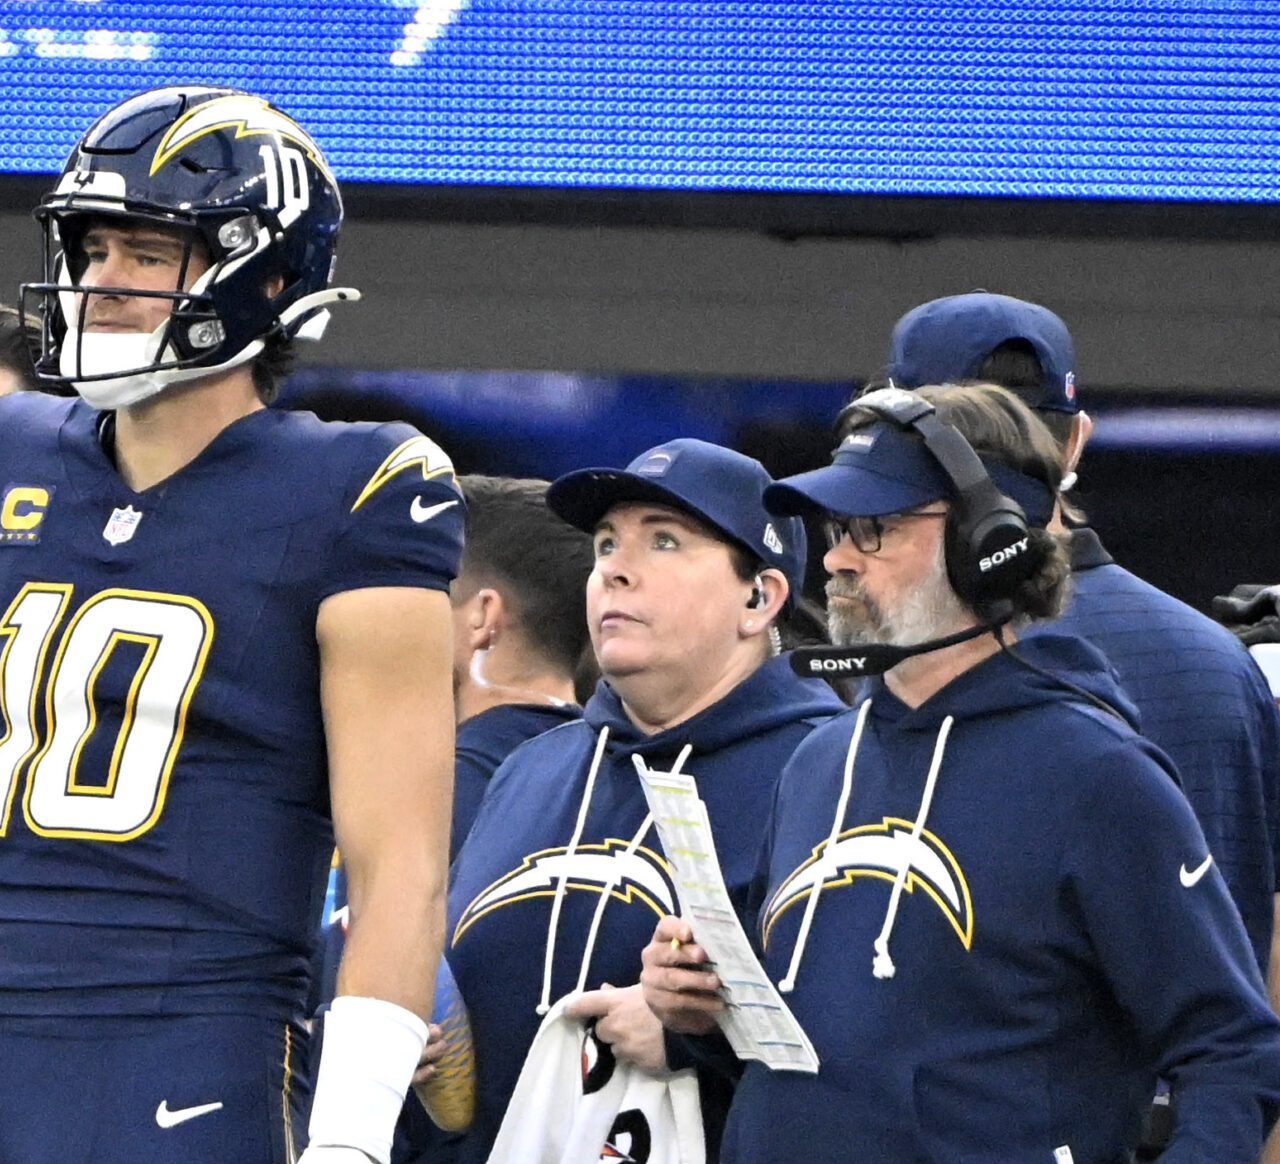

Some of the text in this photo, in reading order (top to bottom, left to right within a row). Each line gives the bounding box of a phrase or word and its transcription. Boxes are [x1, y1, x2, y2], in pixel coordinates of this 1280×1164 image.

[258, 144, 310, 211] 10
[0, 487, 49, 530] C
[979, 537, 1029, 572] SONY
[809, 657, 867, 671] SONY
